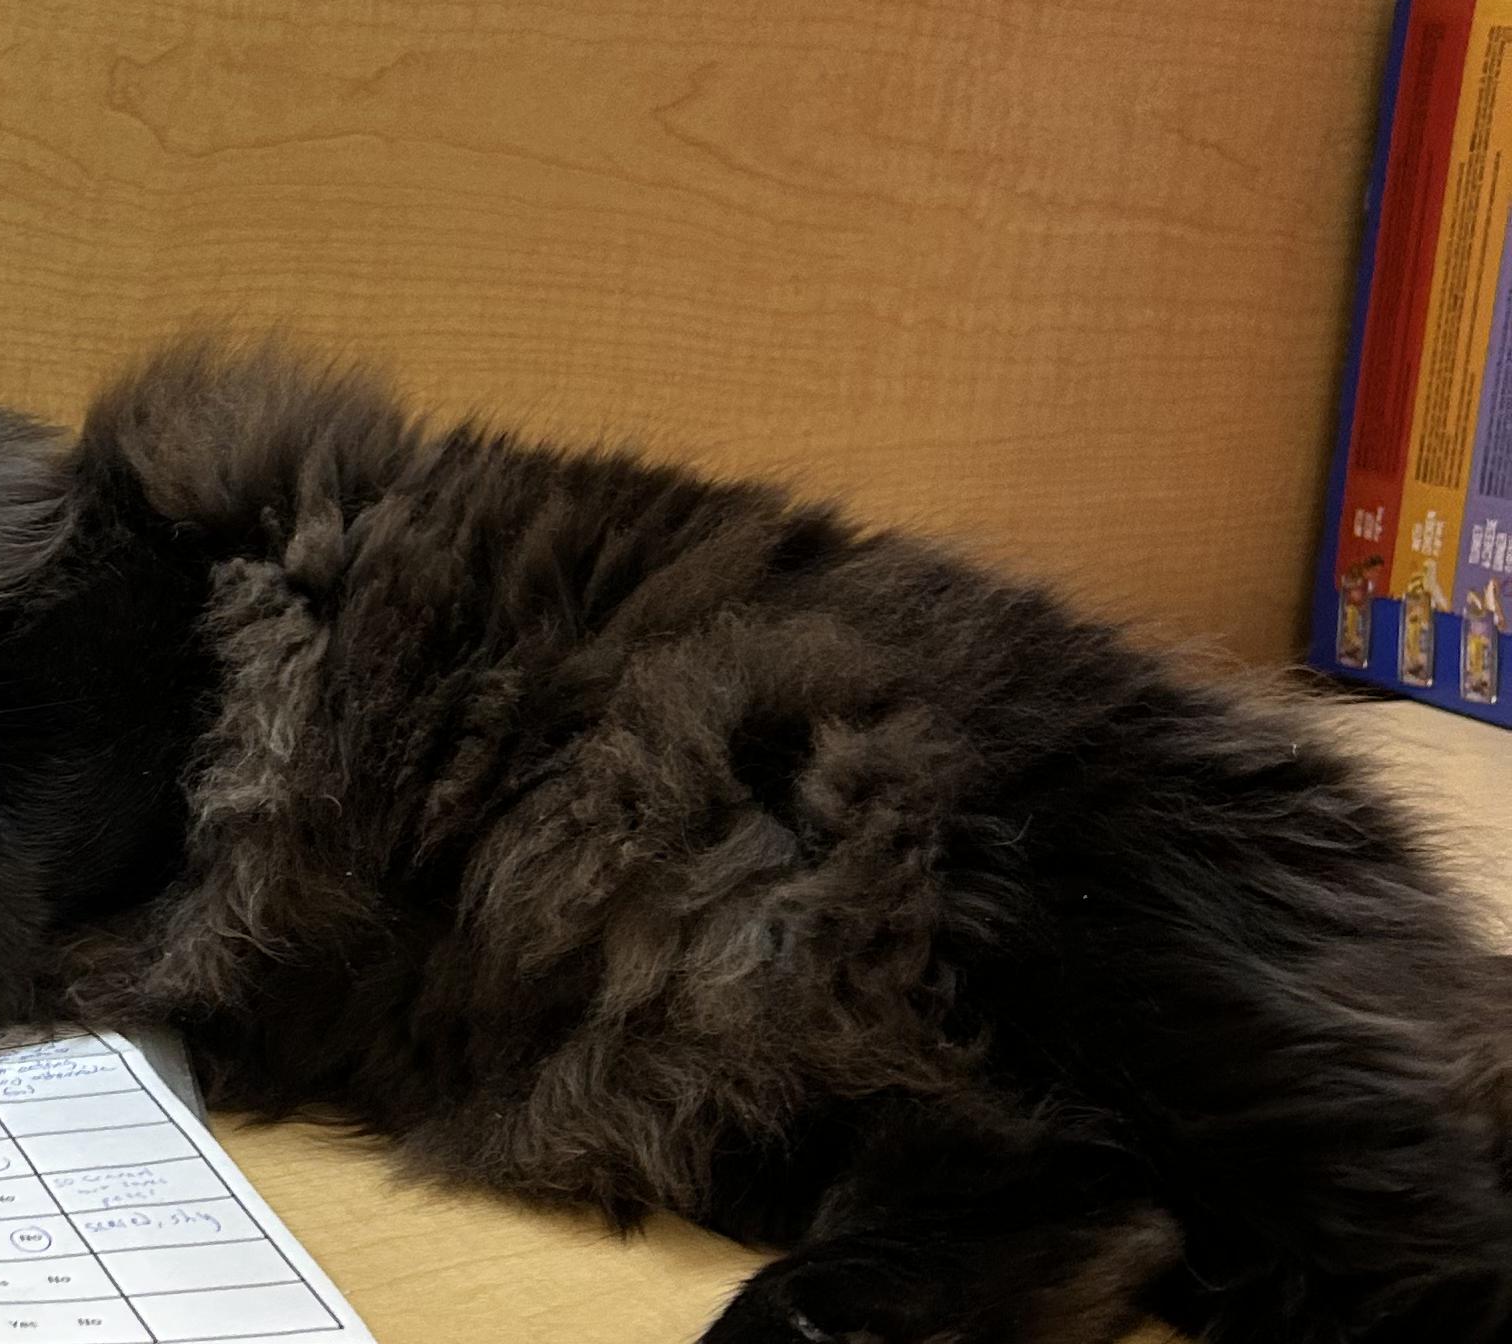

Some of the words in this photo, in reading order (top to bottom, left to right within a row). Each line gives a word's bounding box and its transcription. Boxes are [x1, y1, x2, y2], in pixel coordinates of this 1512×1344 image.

[19, 1233, 43, 1243] No
[47, 1275, 71, 1284] No
[8, 1320, 38, 1329] Yes
[77, 1317, 102, 1326] No
